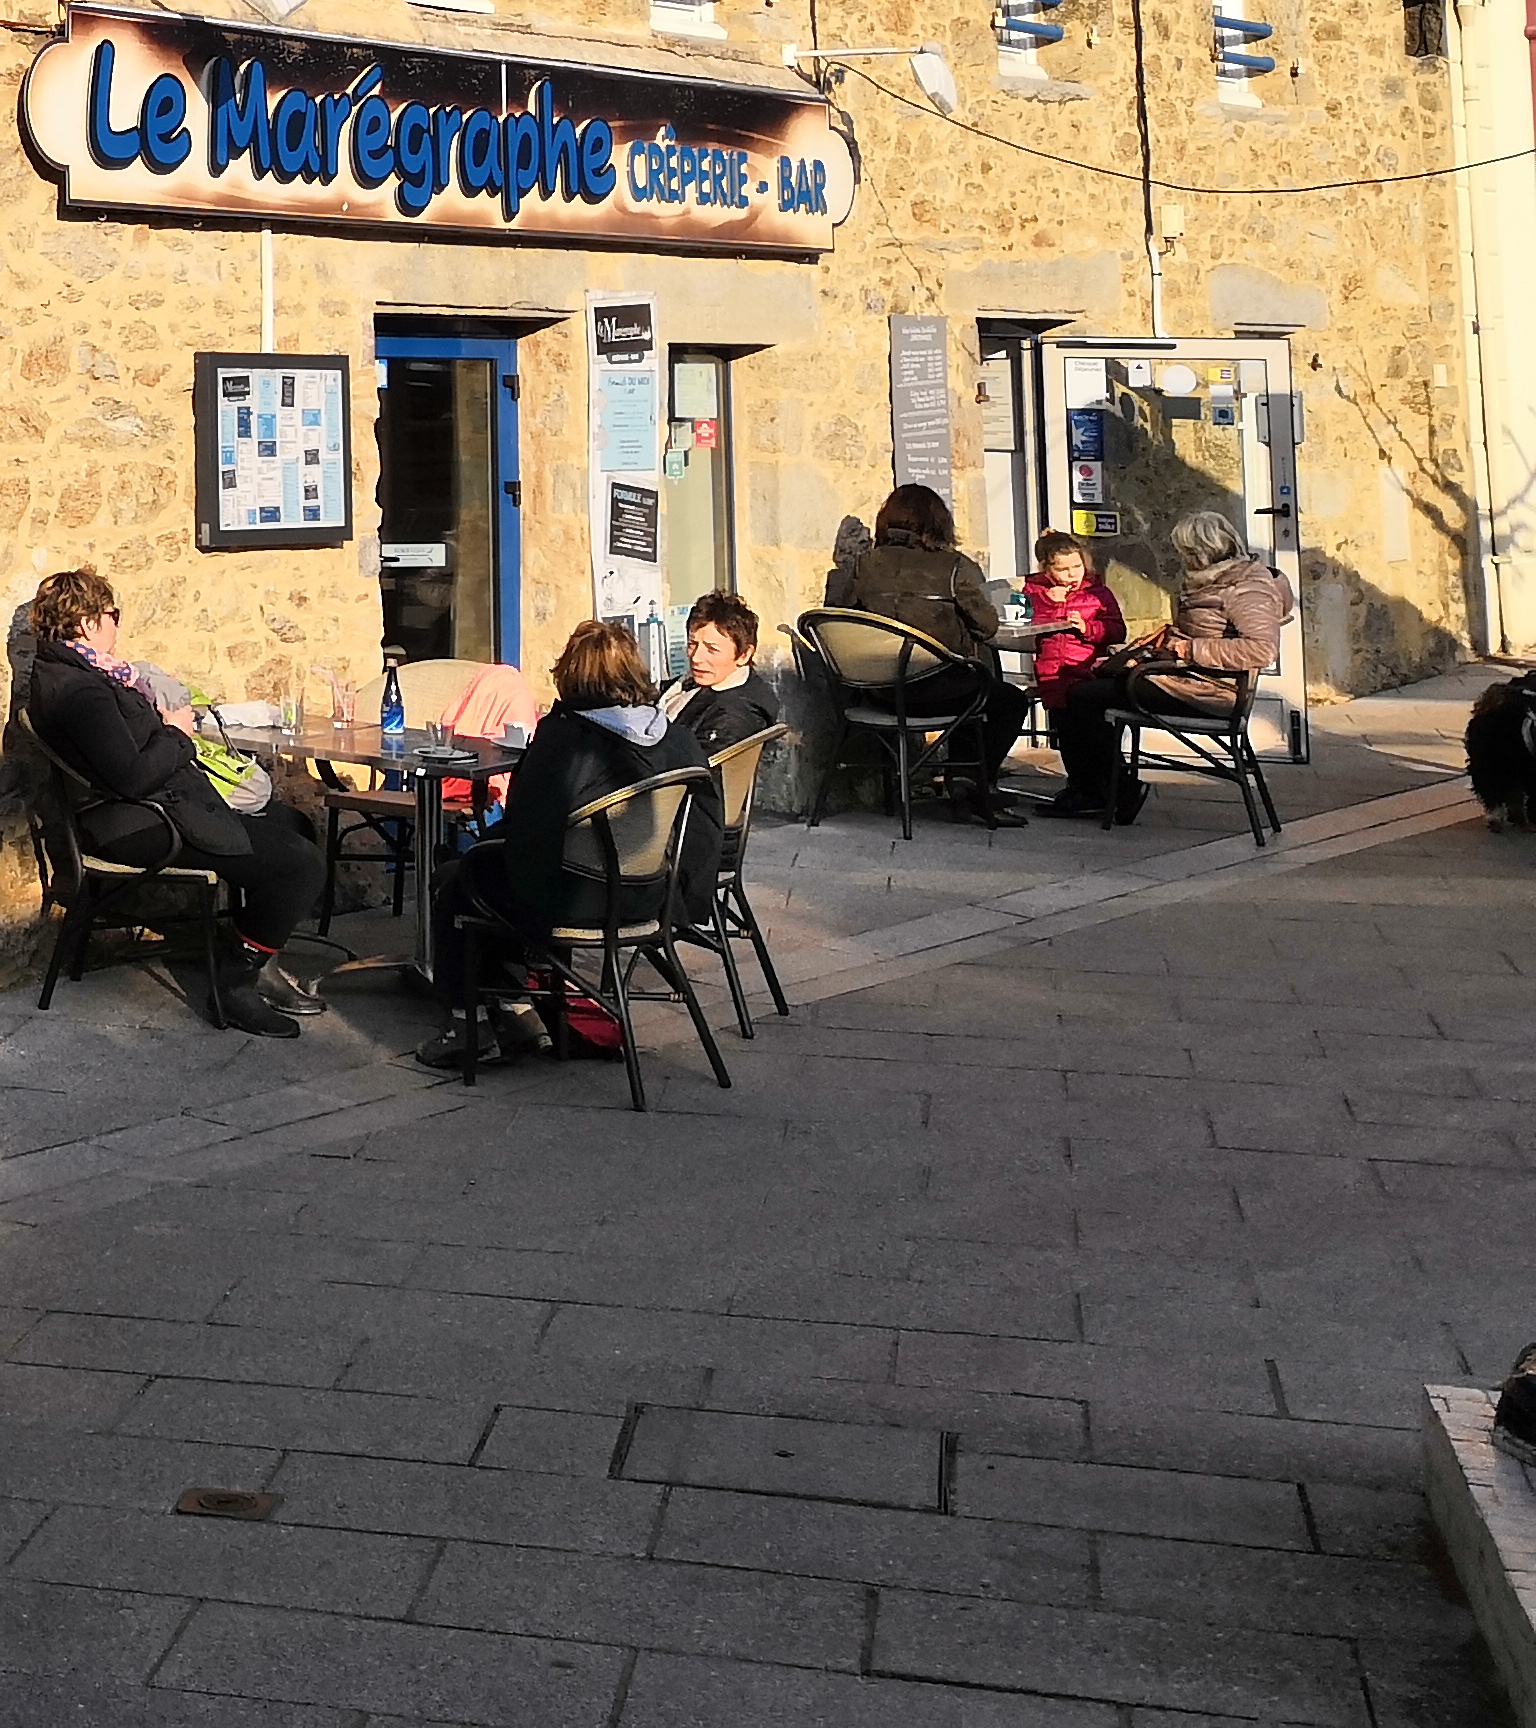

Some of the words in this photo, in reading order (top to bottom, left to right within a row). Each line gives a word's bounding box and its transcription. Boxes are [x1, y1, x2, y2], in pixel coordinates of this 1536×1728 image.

[86, 39, 192, 175] Le
[207, 56, 617, 222] Marégraphe
[627, 122, 750, 209] CRÊPERIE
[777, 154, 828, 217] BAR
